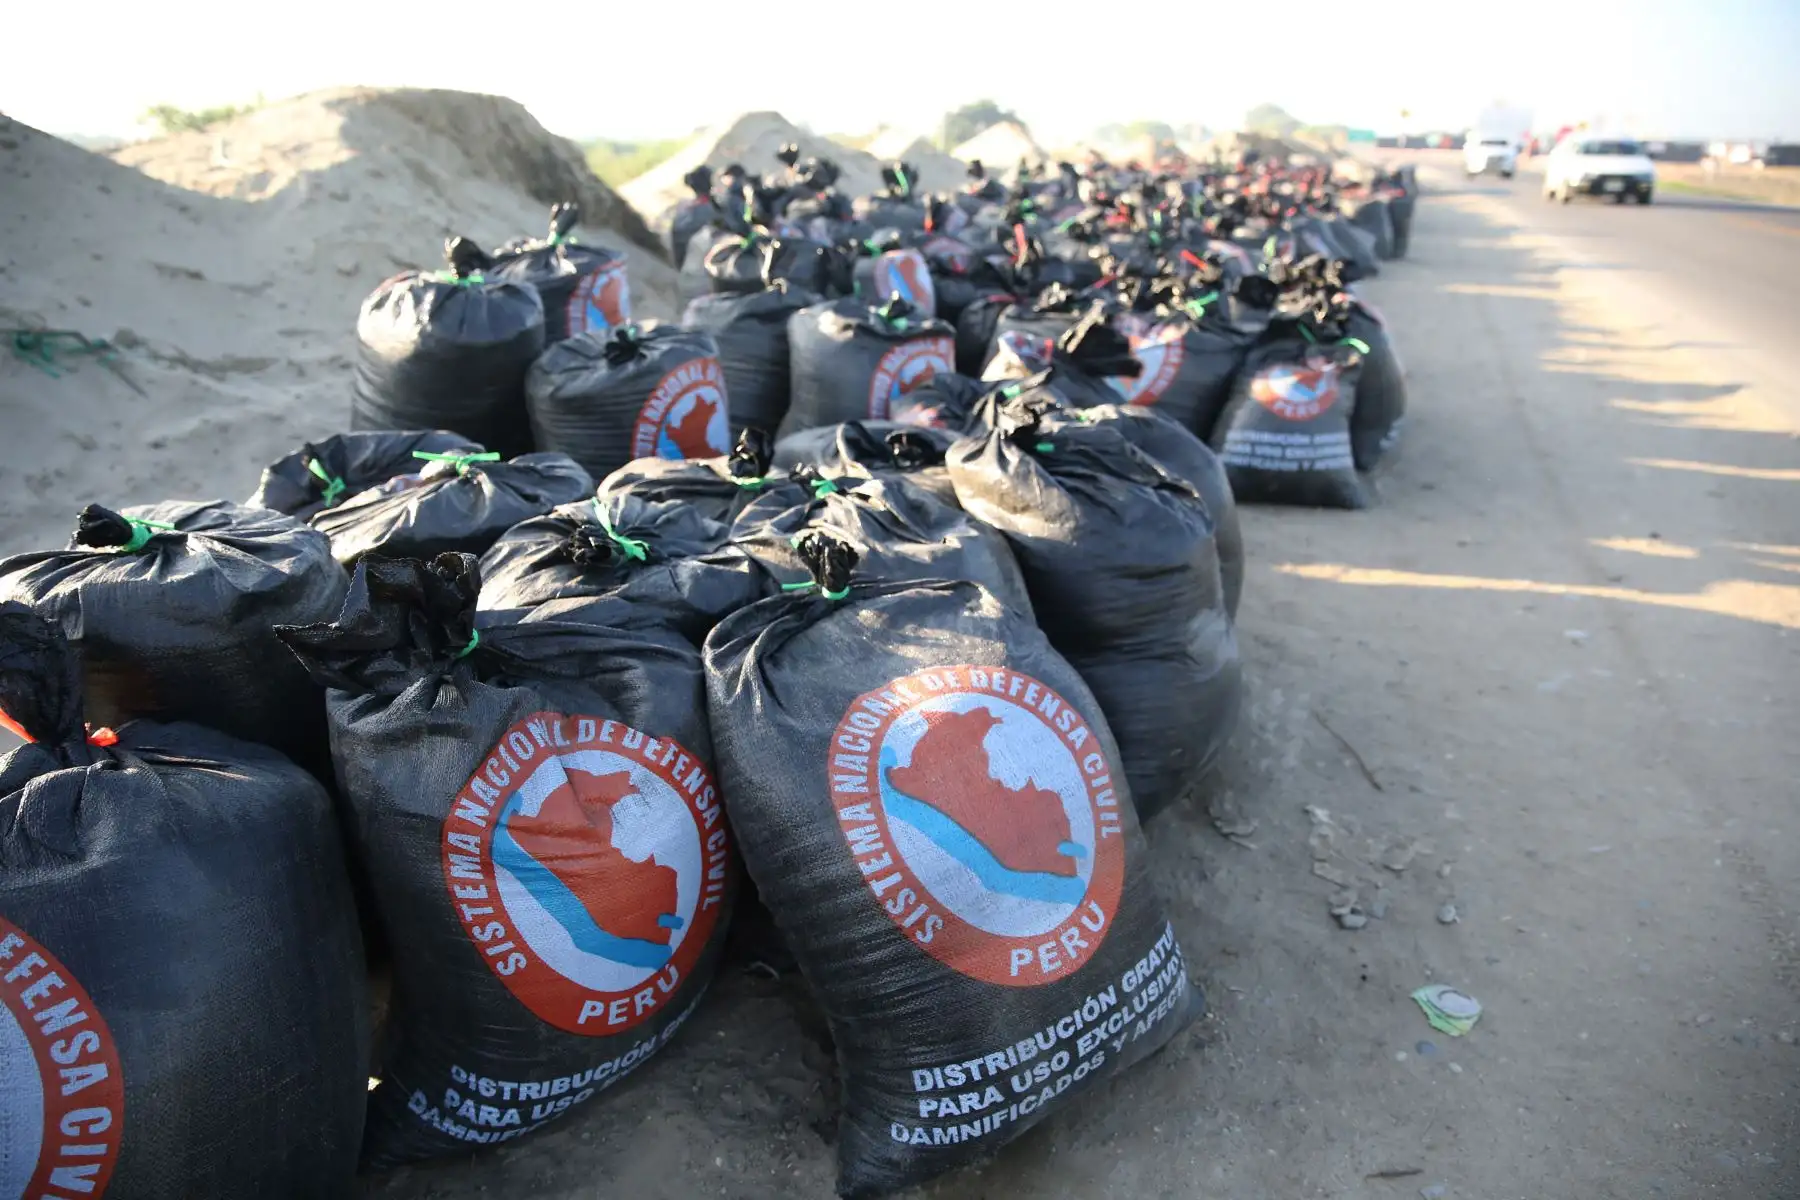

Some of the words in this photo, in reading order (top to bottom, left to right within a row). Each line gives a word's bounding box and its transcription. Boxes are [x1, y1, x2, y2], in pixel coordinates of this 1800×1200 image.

[454, 718, 570, 829] NACIONL
[577, 719, 617, 743] DE
[839, 802, 944, 944] SISTEMA
[920, 669, 962, 691] DE
[969, 667, 1089, 750] DEFENSA
[1084, 752, 1122, 840] CIVIL
[447, 831, 527, 976] SISTEMA
[702, 828, 726, 911] CIVIL
[450, 1034, 658, 1101] DISTRIBUCIÓN
[911, 985, 1118, 1093] DISTRIBUCIÓN
[918, 1085, 1005, 1118] PARA
[1011, 1050, 1070, 1094] USO
[1076, 954, 1180, 1058] EXCLUSIVO
[443, 1087, 522, 1127] PARA
[531, 1087, 595, 1120] USO
[890, 1050, 1106, 1146] DAMNIFICADOS
[40, 1105, 113, 1200] CIV
